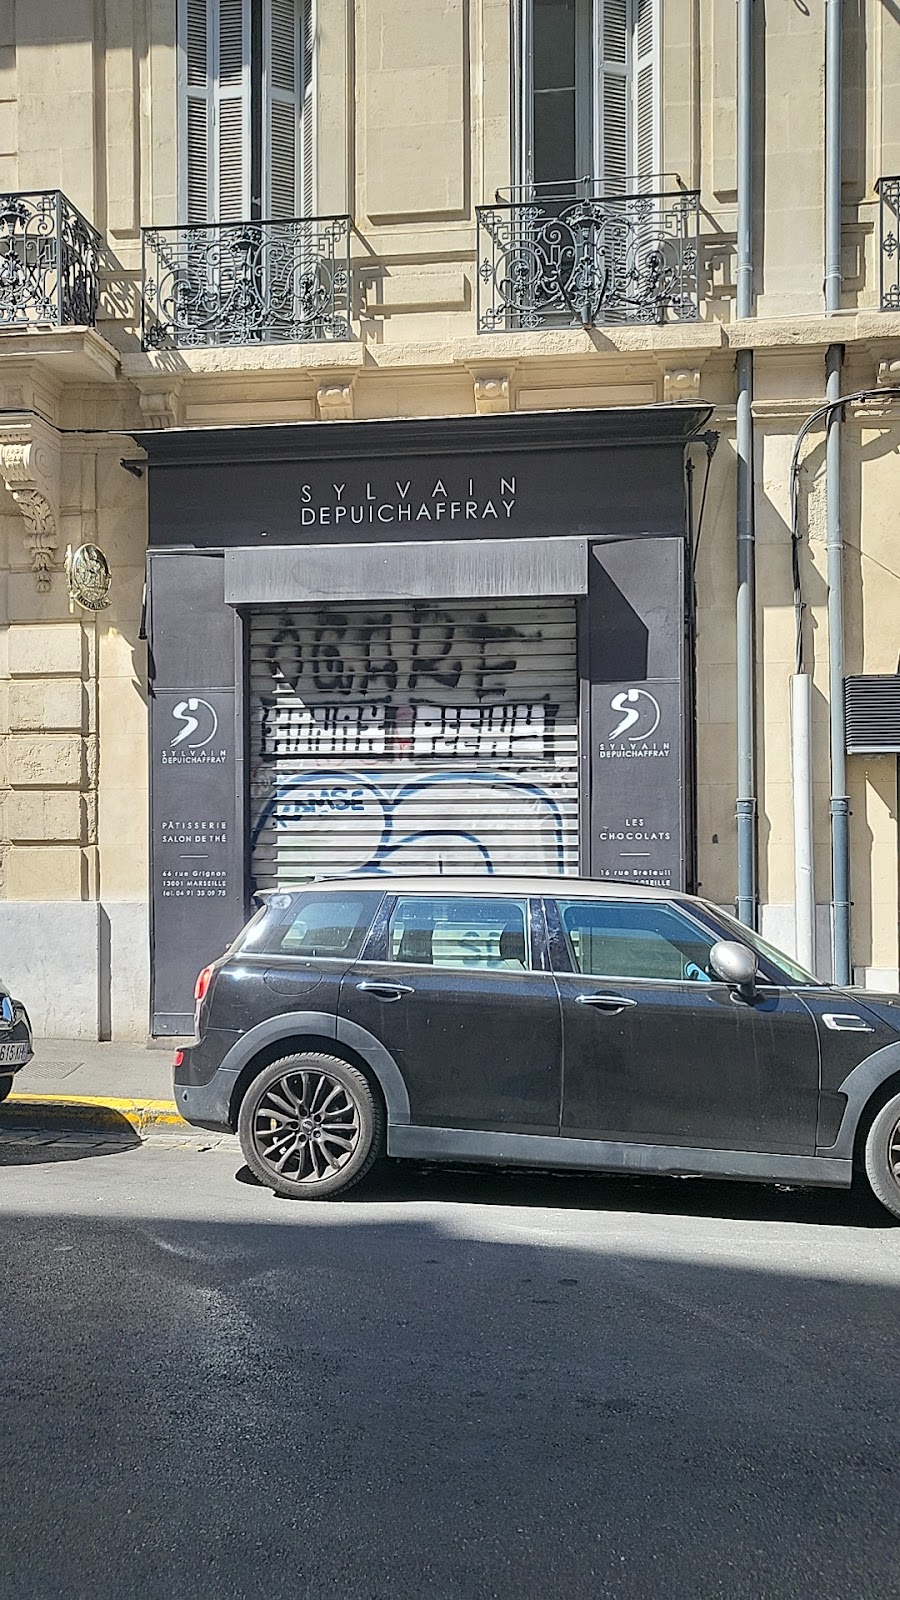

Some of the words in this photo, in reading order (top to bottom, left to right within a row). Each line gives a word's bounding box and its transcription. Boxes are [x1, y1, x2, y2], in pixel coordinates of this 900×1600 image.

[301, 477, 516, 502] SYLVAIN
[301, 500, 515, 525] DEPUICHAFFRAY
[600, 742, 670, 750] SYLVAIN
[162, 749, 226, 757] SYLVAIN
[600, 750, 670, 758] DEPUICHAFFRAY
[162, 756, 226, 764] DEPUICHAFFRAY
[162, 821, 226, 829] PÂTISSERIE
[625, 818, 644, 826] LES
[209, 833, 226, 842] THÉ
[600, 832, 671, 840] CHOCOLATS
[192, 870, 227, 878] Grignon
